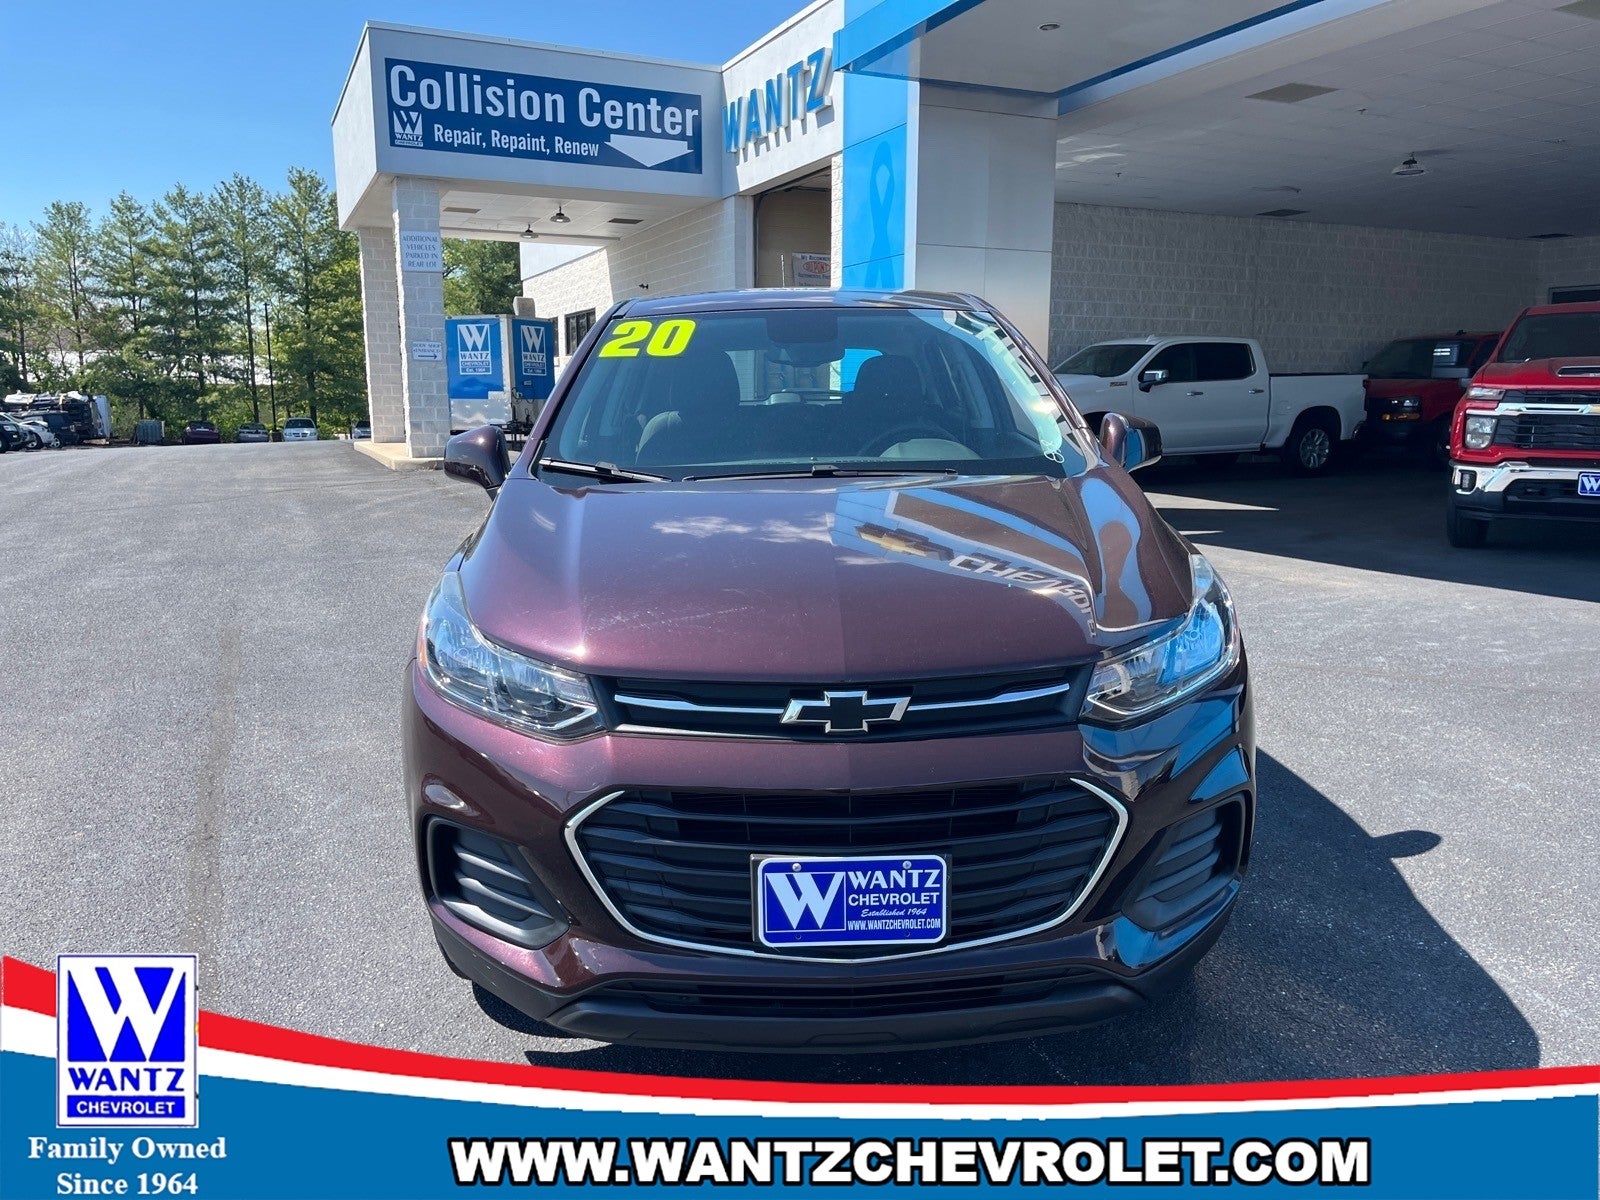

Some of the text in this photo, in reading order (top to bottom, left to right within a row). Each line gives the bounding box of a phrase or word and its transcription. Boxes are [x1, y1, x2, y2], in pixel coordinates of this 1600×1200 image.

[390, 65, 699, 136] Collision Center
[722, 47, 831, 153] WANTZ
[395, 133, 423, 142] WANTZ
[434, 124, 599, 157] Repair, Repaint, Renew
[460, 325, 488, 351] W
[522, 327, 544, 353] W
[598, 319, 696, 357] 20
[847, 869, 941, 890] WANTZ
[765, 872, 846, 930] W
[848, 892, 940, 906] CHEVROLET
[847, 918, 941, 931] WWW.WANTZCHEVROLET.COM
[861, 908, 927, 918] Established 1964
